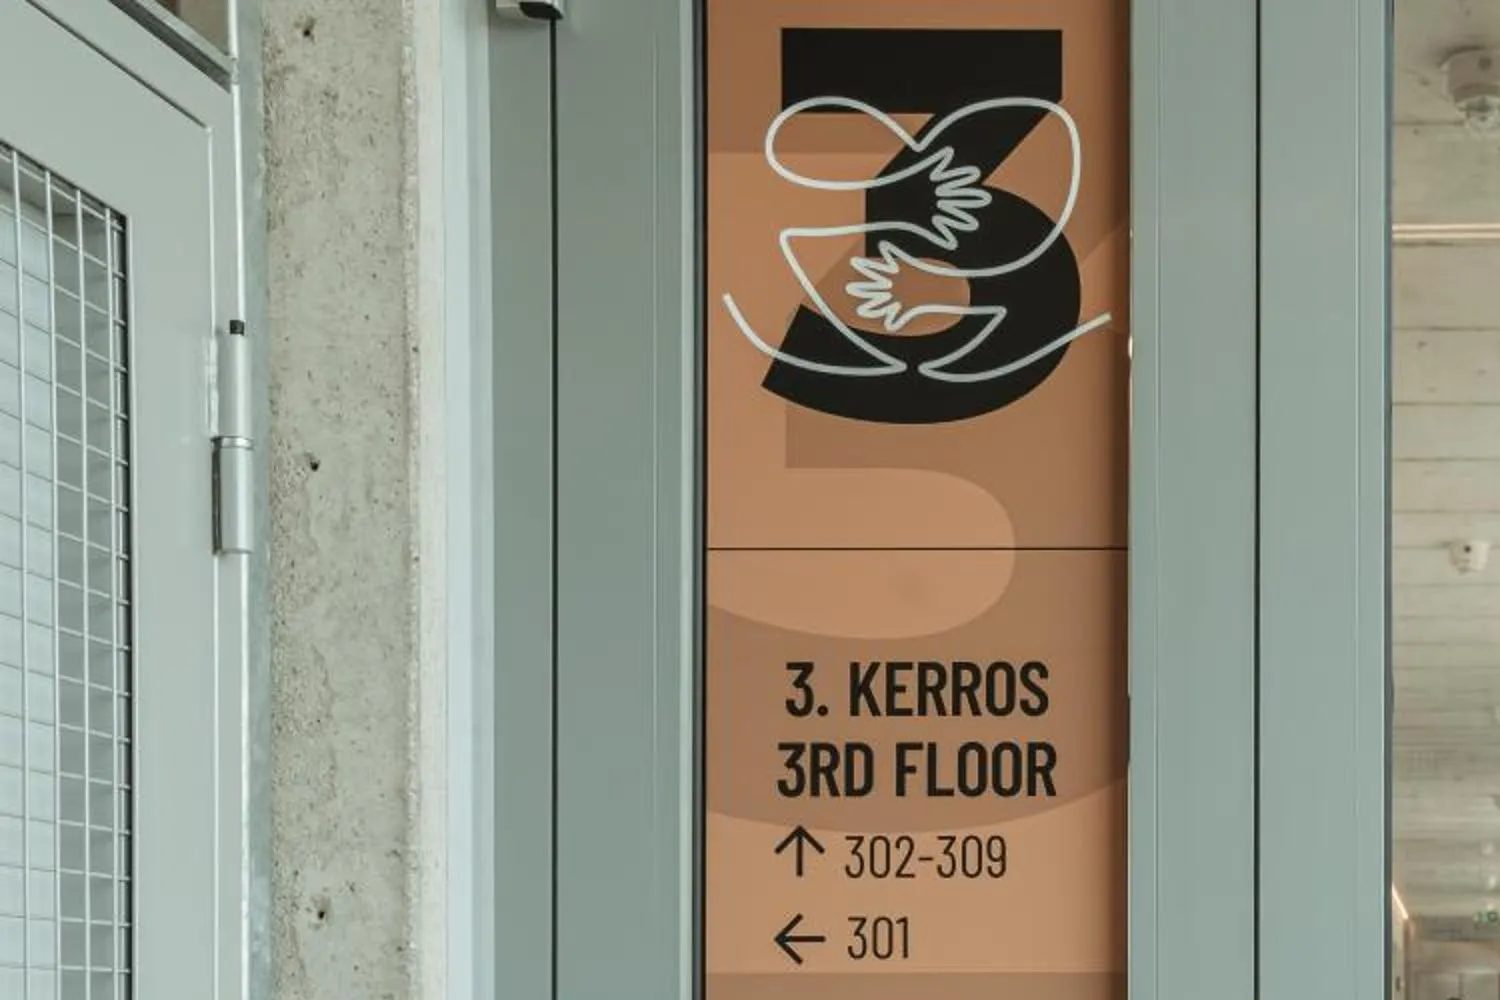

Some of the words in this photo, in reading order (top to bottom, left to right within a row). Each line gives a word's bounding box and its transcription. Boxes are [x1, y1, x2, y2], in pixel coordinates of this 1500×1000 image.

[785, 661, 829, 718] 3.
[849, 661, 1049, 718] KERROS
[776, 741, 875, 799] 3RD
[895, 741, 1057, 798] FLOOR
[844, 834, 1007, 879] 302-309
[847, 916, 909, 961] 301
